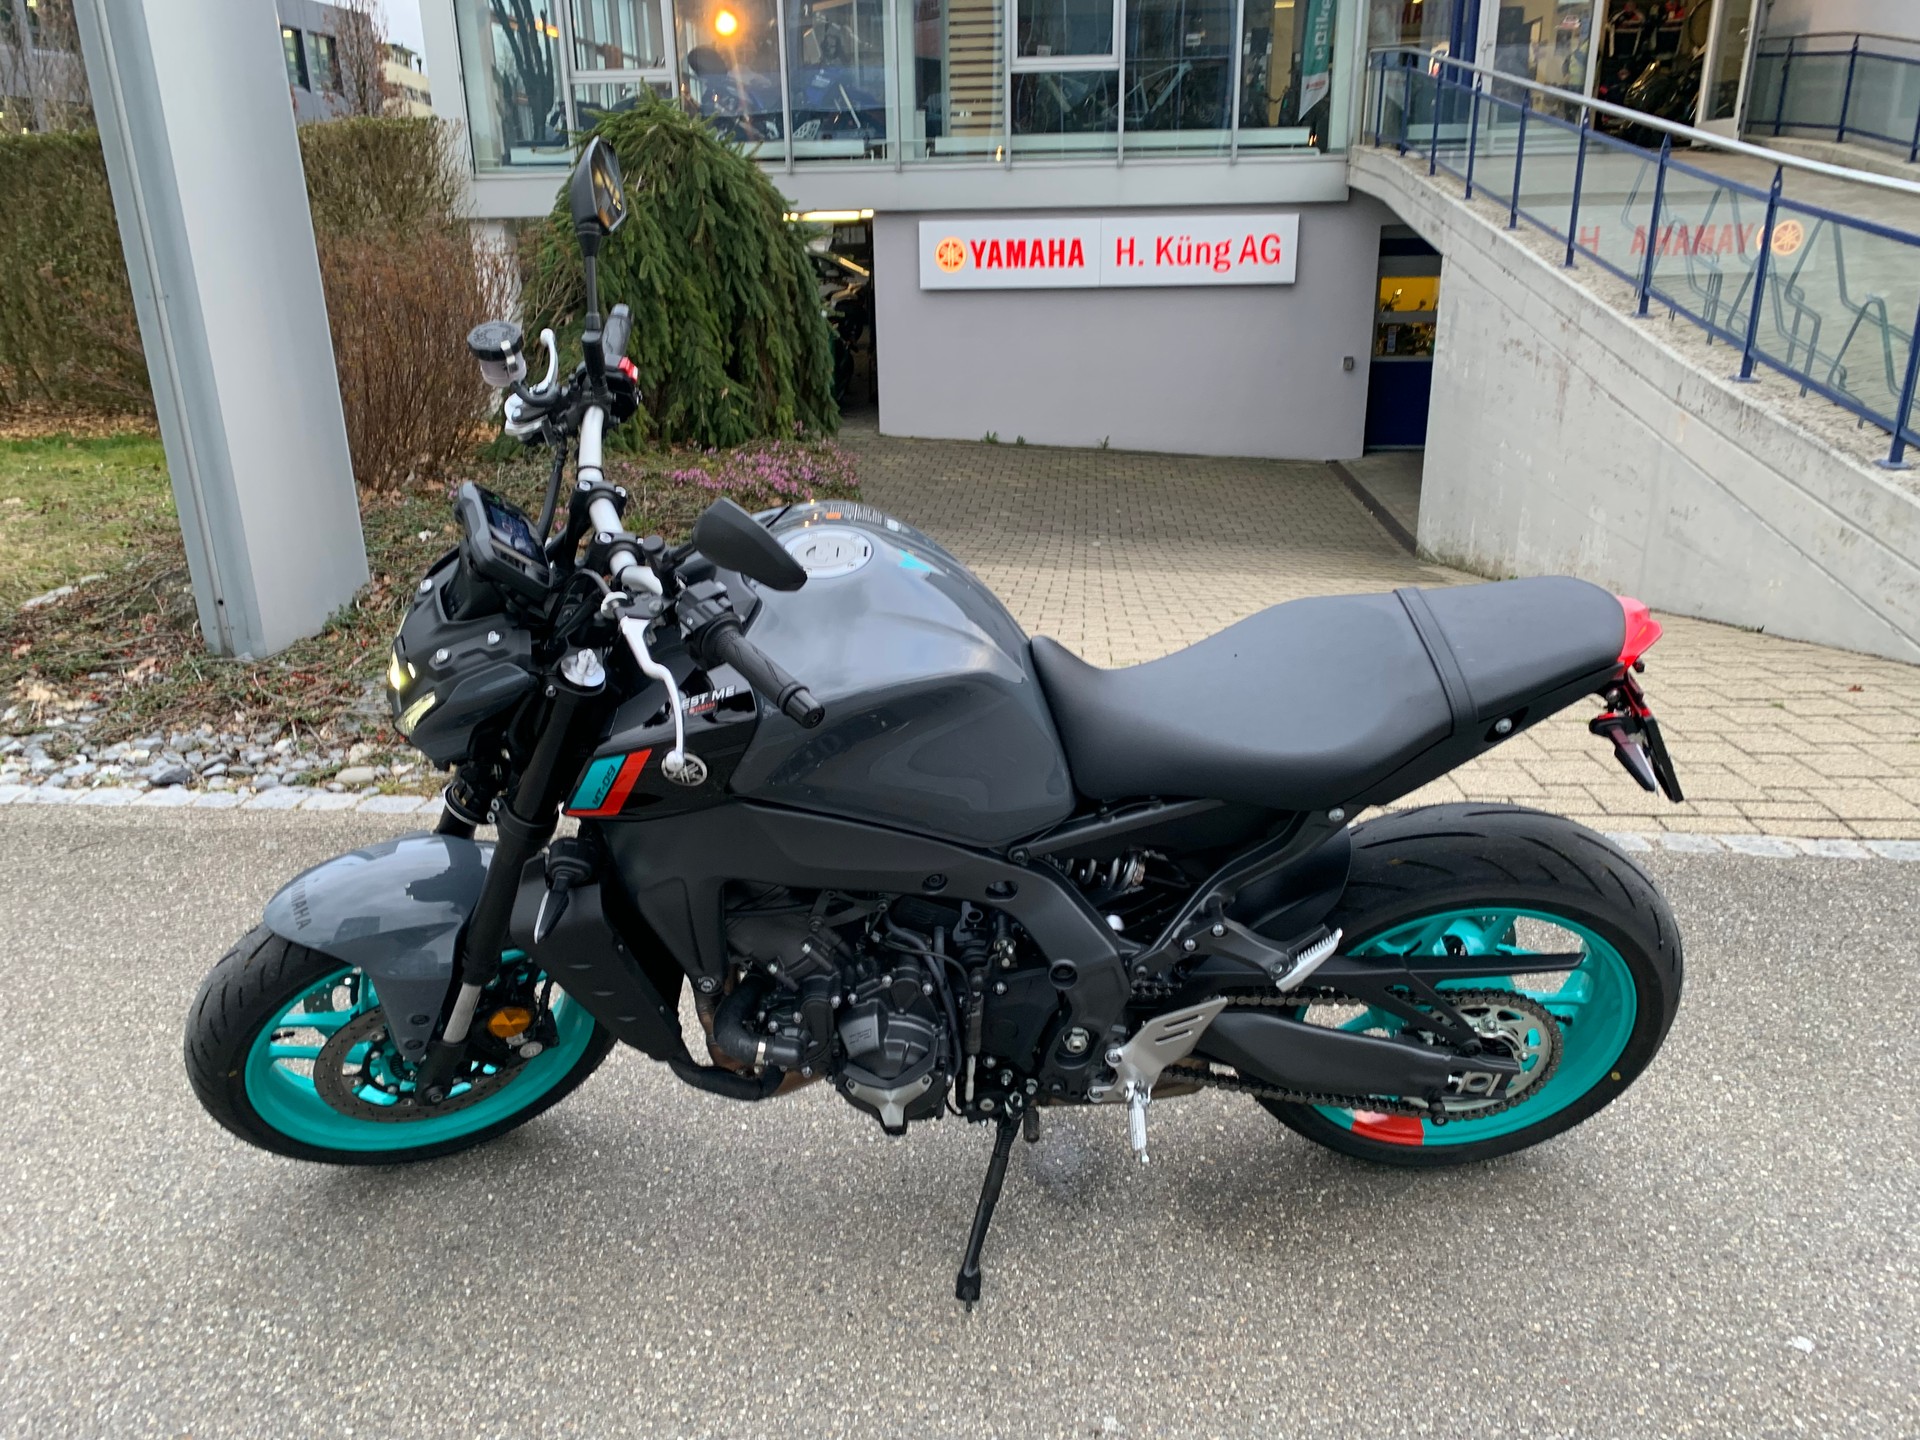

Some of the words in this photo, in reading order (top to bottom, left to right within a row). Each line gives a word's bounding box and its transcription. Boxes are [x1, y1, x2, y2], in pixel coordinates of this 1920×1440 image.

[971, 238, 1085, 269] YAMAHA
[1116, 236, 1144, 267] H.
[1155, 235, 1232, 273] Küng
[1238, 233, 1282, 265] AG
[682, 692, 708, 710] EST
[712, 685, 735, 702] ME
